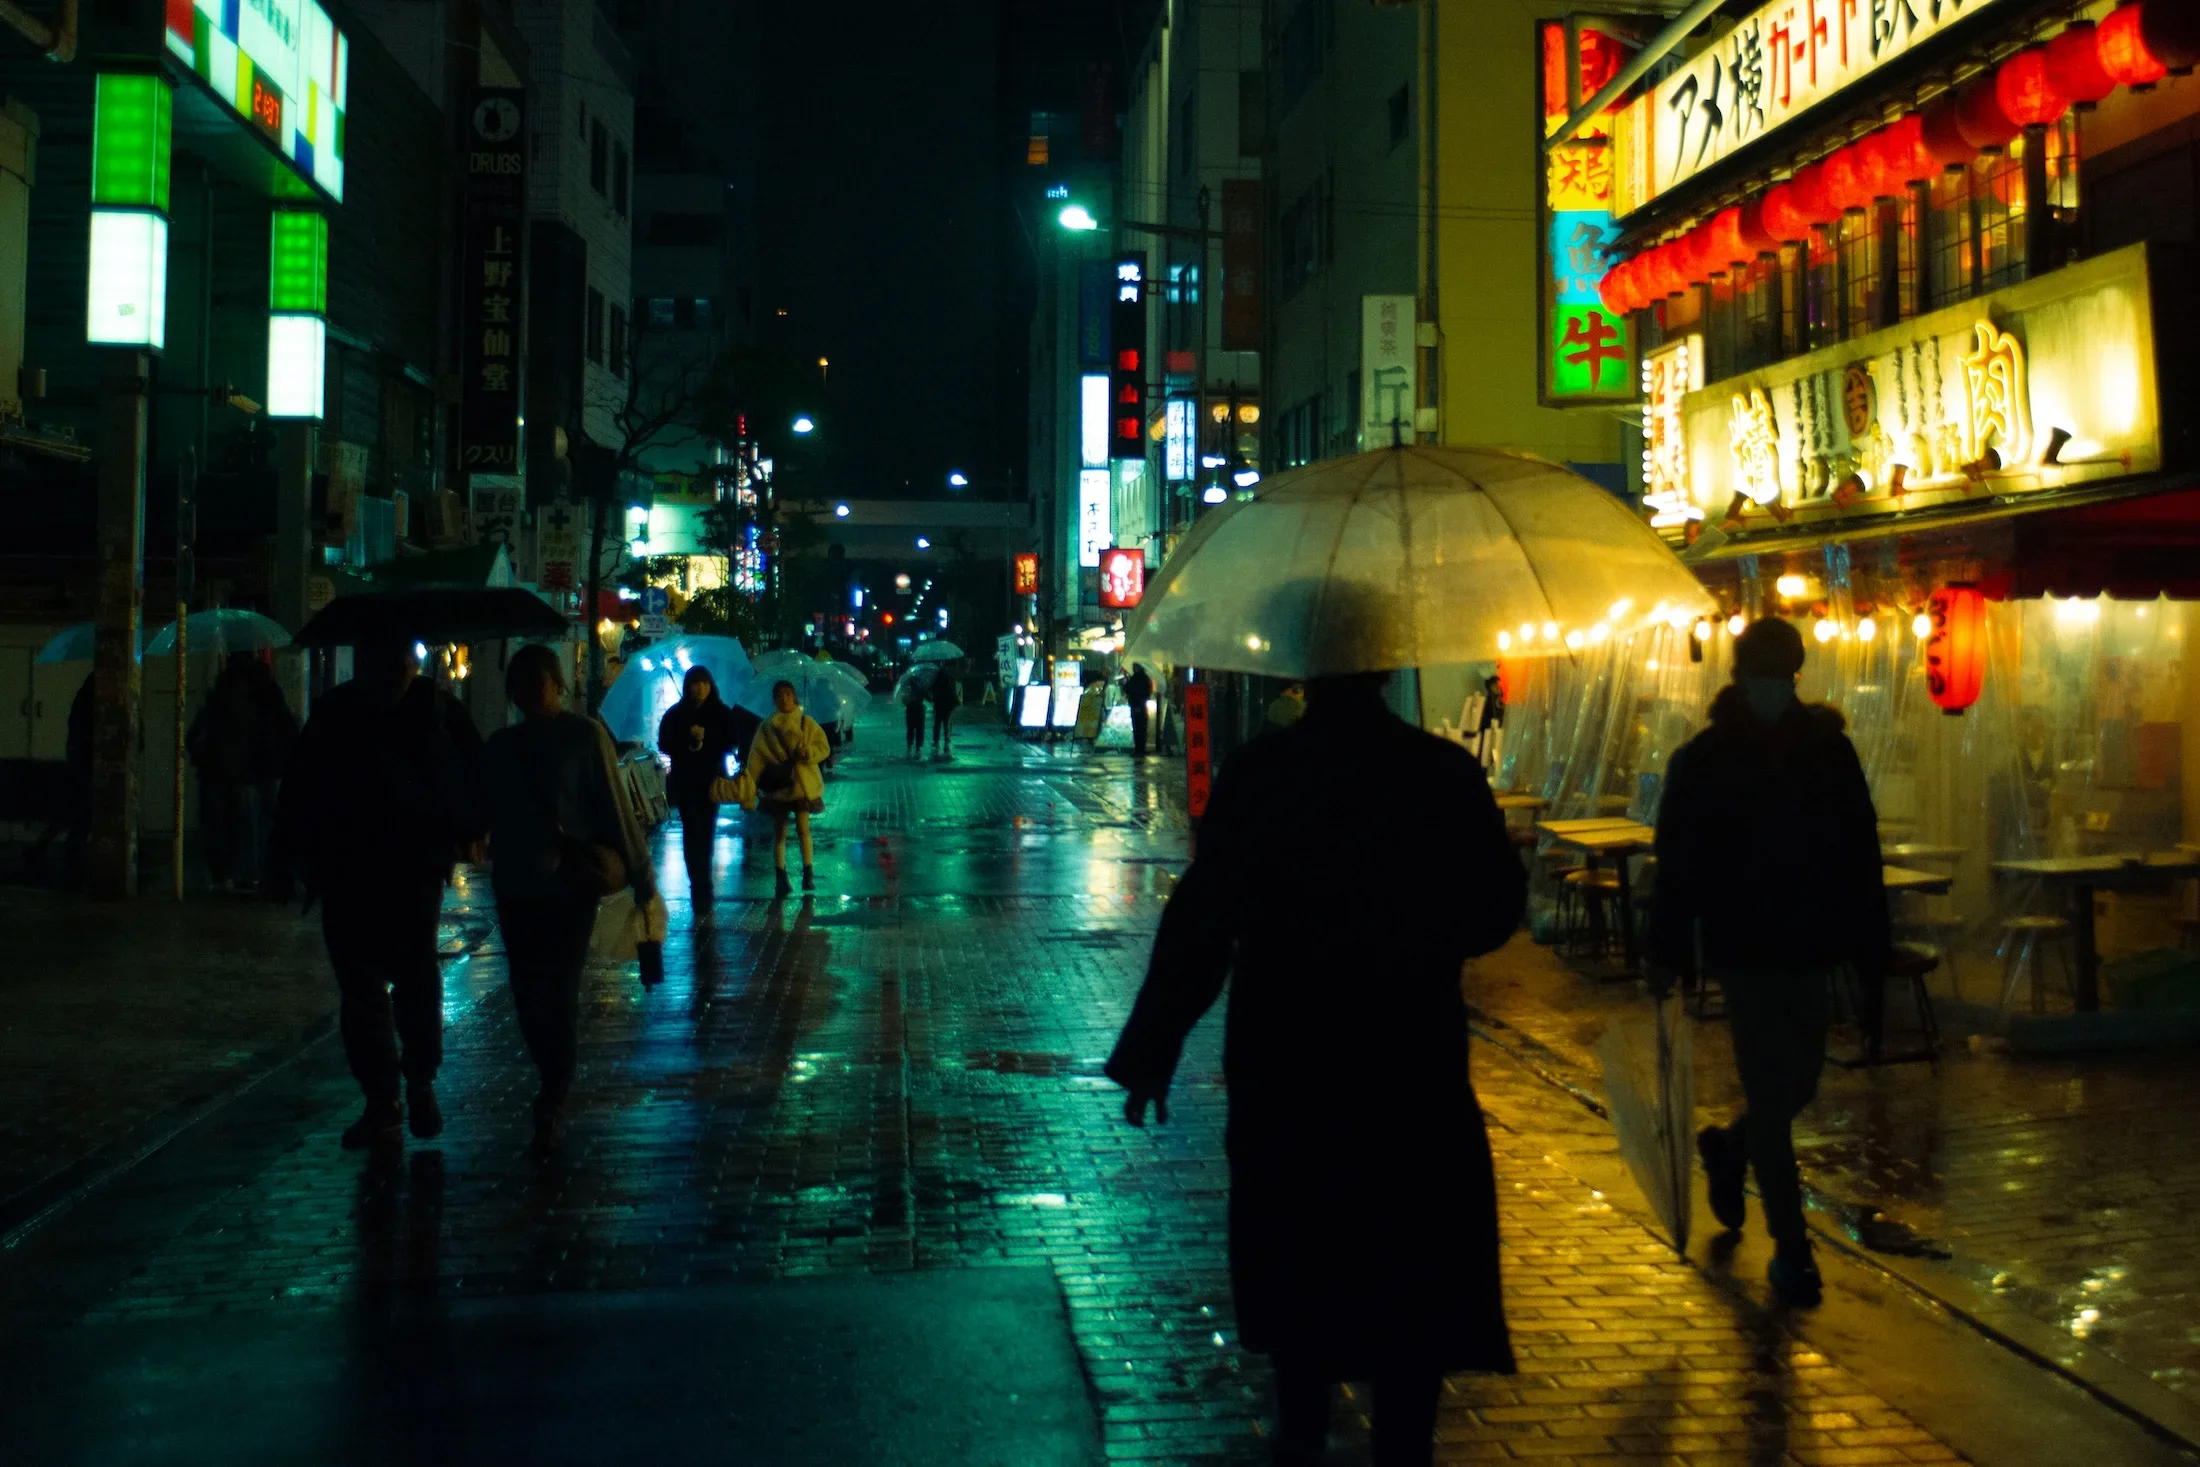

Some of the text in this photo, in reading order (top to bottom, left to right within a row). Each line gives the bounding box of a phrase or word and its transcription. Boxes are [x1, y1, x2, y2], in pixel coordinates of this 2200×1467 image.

[470, 152, 522, 175] DRUGS
[465, 444, 514, 465] クスリ
